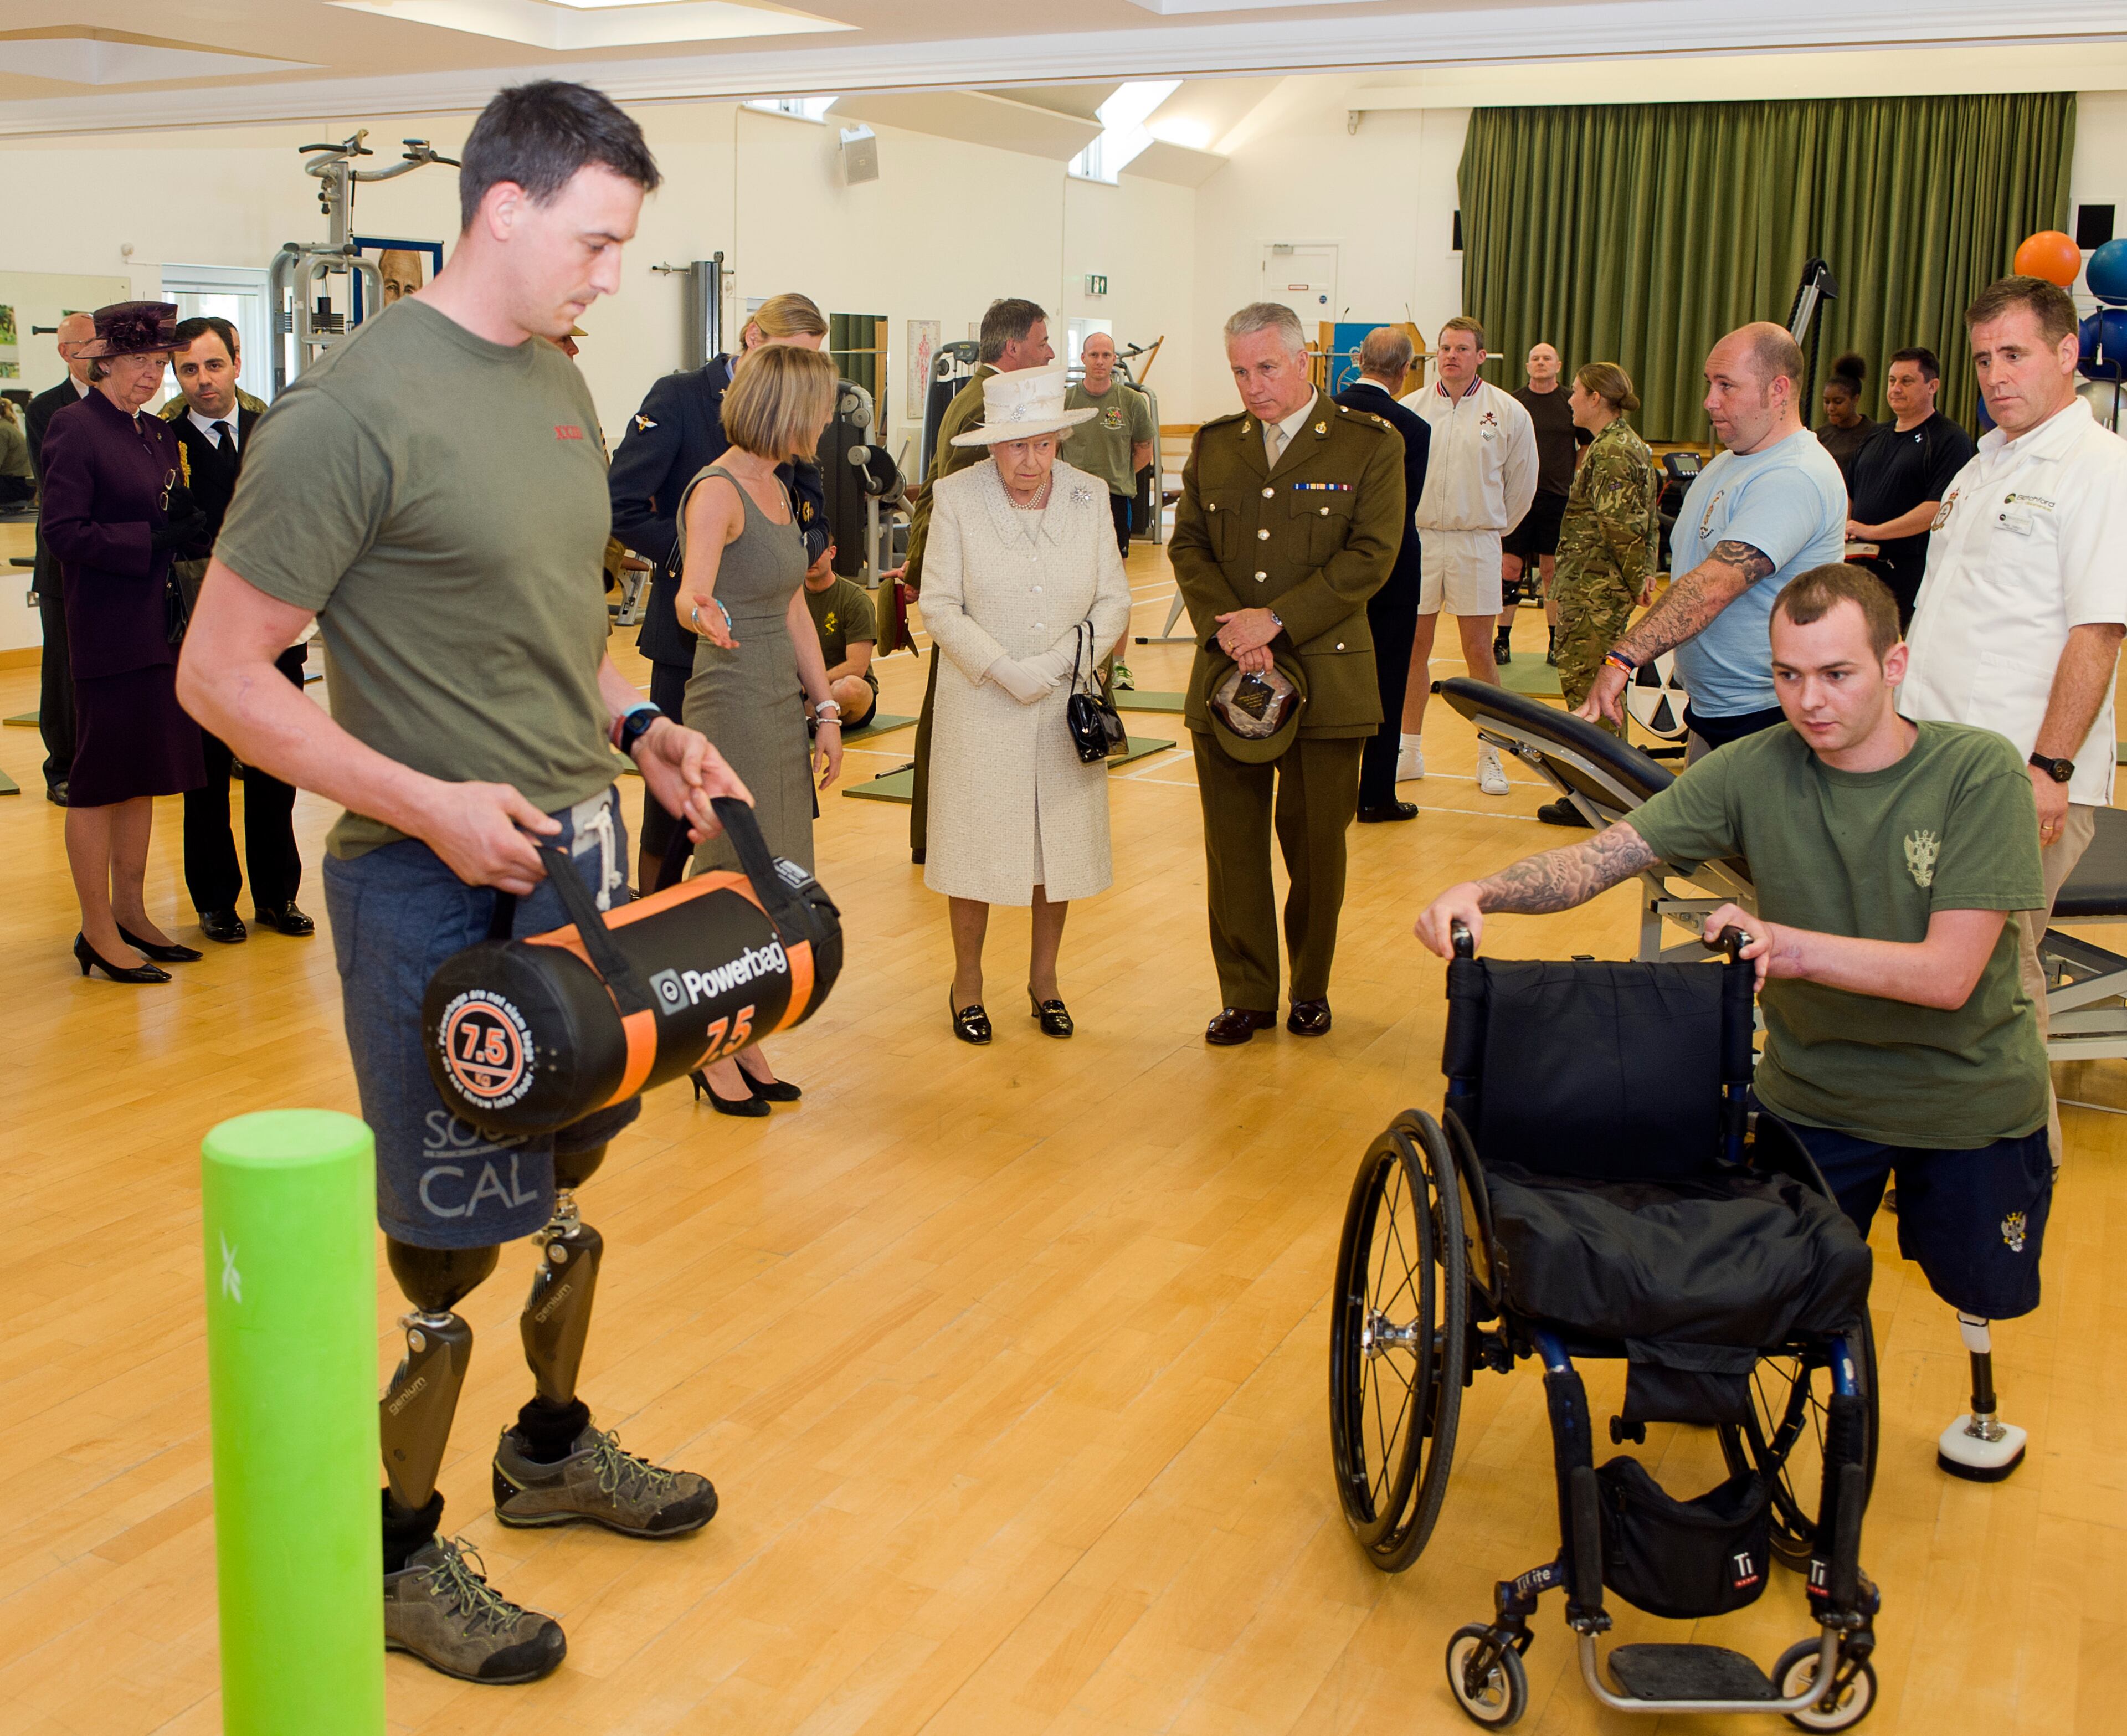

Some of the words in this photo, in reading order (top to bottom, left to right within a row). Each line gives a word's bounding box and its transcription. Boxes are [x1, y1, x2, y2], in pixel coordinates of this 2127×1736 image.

[682, 941, 787, 1005] Powerbag
[460, 1022, 507, 1066] 7.5
[692, 1004, 755, 1068] 7.5
[419, 1154, 539, 1218] CAL
[1734, 1552, 1754, 1576] Ti
[1811, 1560, 1826, 1585] Ti
